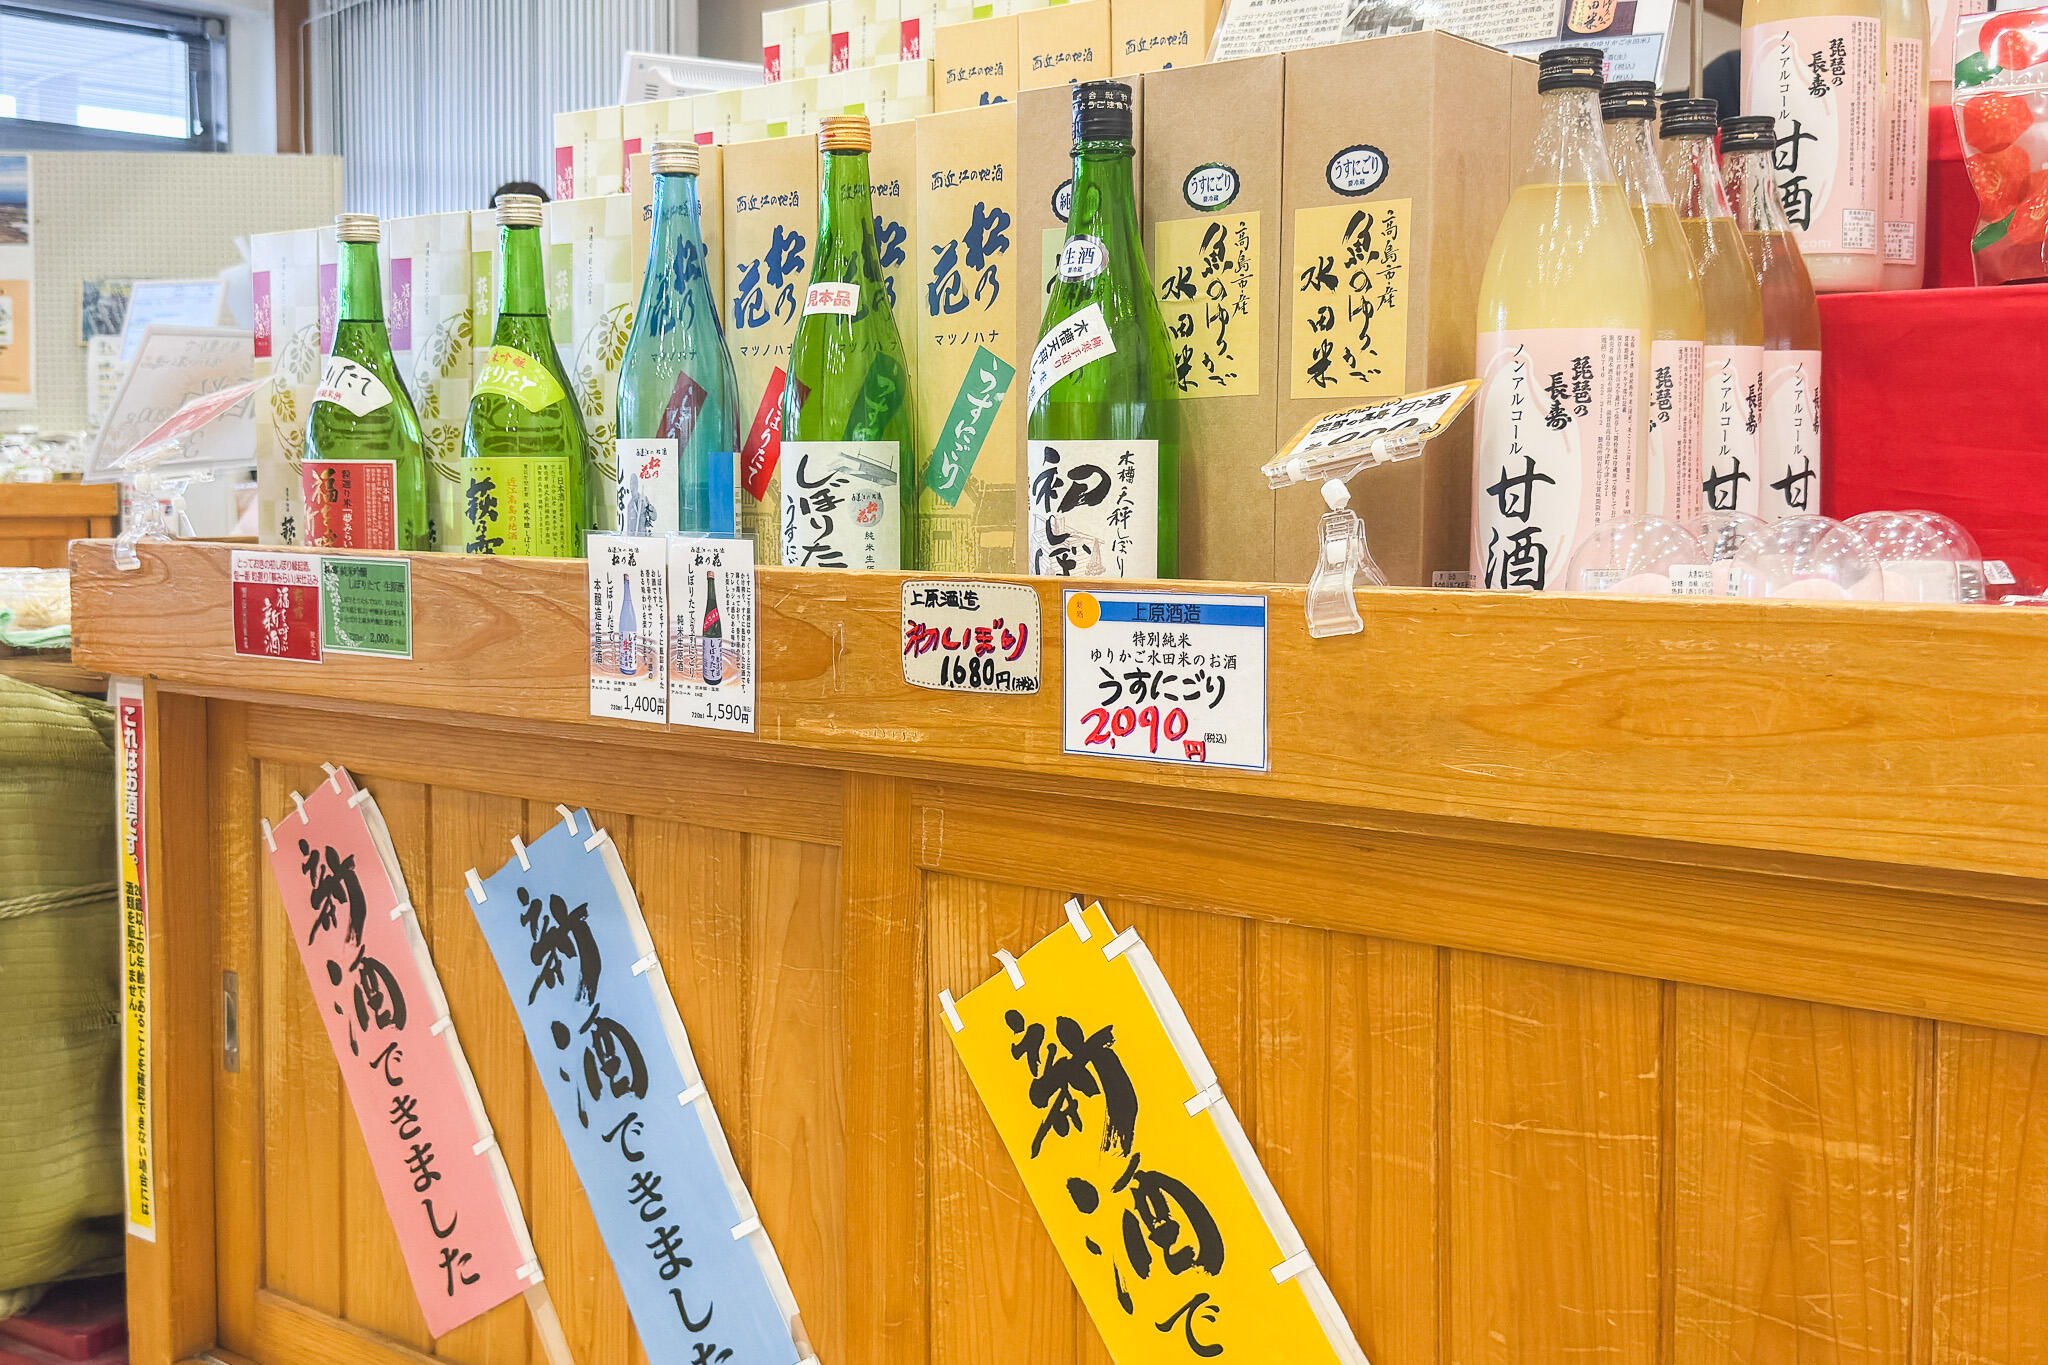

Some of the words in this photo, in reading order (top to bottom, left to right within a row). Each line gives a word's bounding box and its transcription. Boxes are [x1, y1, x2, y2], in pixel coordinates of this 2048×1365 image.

[1032, 48, 1093, 71] 西近江の地酒
[1125, 31, 1188, 55] 西近江の地酒
[946, 62, 1004, 84] 西近江の地酒
[1778, 30, 1791, 121] ノンアルコール
[1808, 51, 1830, 97] 長寿
[931, 164, 1004, 191] 西近江の地酒
[1335, 155, 1379, 178] うすにごり
[736, 191, 799, 213] 西近江の地酒
[1191, 174, 1231, 195] うすにごり
[806, 289, 852, 307] 見本品
[935, 330, 999, 346] マツノハナ
[1300, 256, 1338, 388] 水田米
[1509, 344, 1527, 455] ノンアルコール
[1544, 372, 1572, 431] 長寿
[1718, 358, 1731, 457] ノンアルコール
[1793, 362, 1803, 455] ノンアルコール
[1107, 450, 1135, 578] 木槽天秤しぼり
[1485, 455, 1556, 590] 甘酒
[606, 571, 615, 642] しぼりたて
[910, 589, 980, 611] 上原酒造
[1132, 603, 1201, 625] 上原酒造
[904, 617, 1028, 661] 初しぼり
[1132, 631, 1192, 648] 特別純米
[1091, 648, 1237, 670] ゆりかご水田米のお酒
[1099, 666, 1225, 709] うすにごり
[1204, 732, 1227, 744] (税込)
[298, 839, 481, 1297] 新酒できました
[1003, 1009, 1225, 1358] 新酒で
